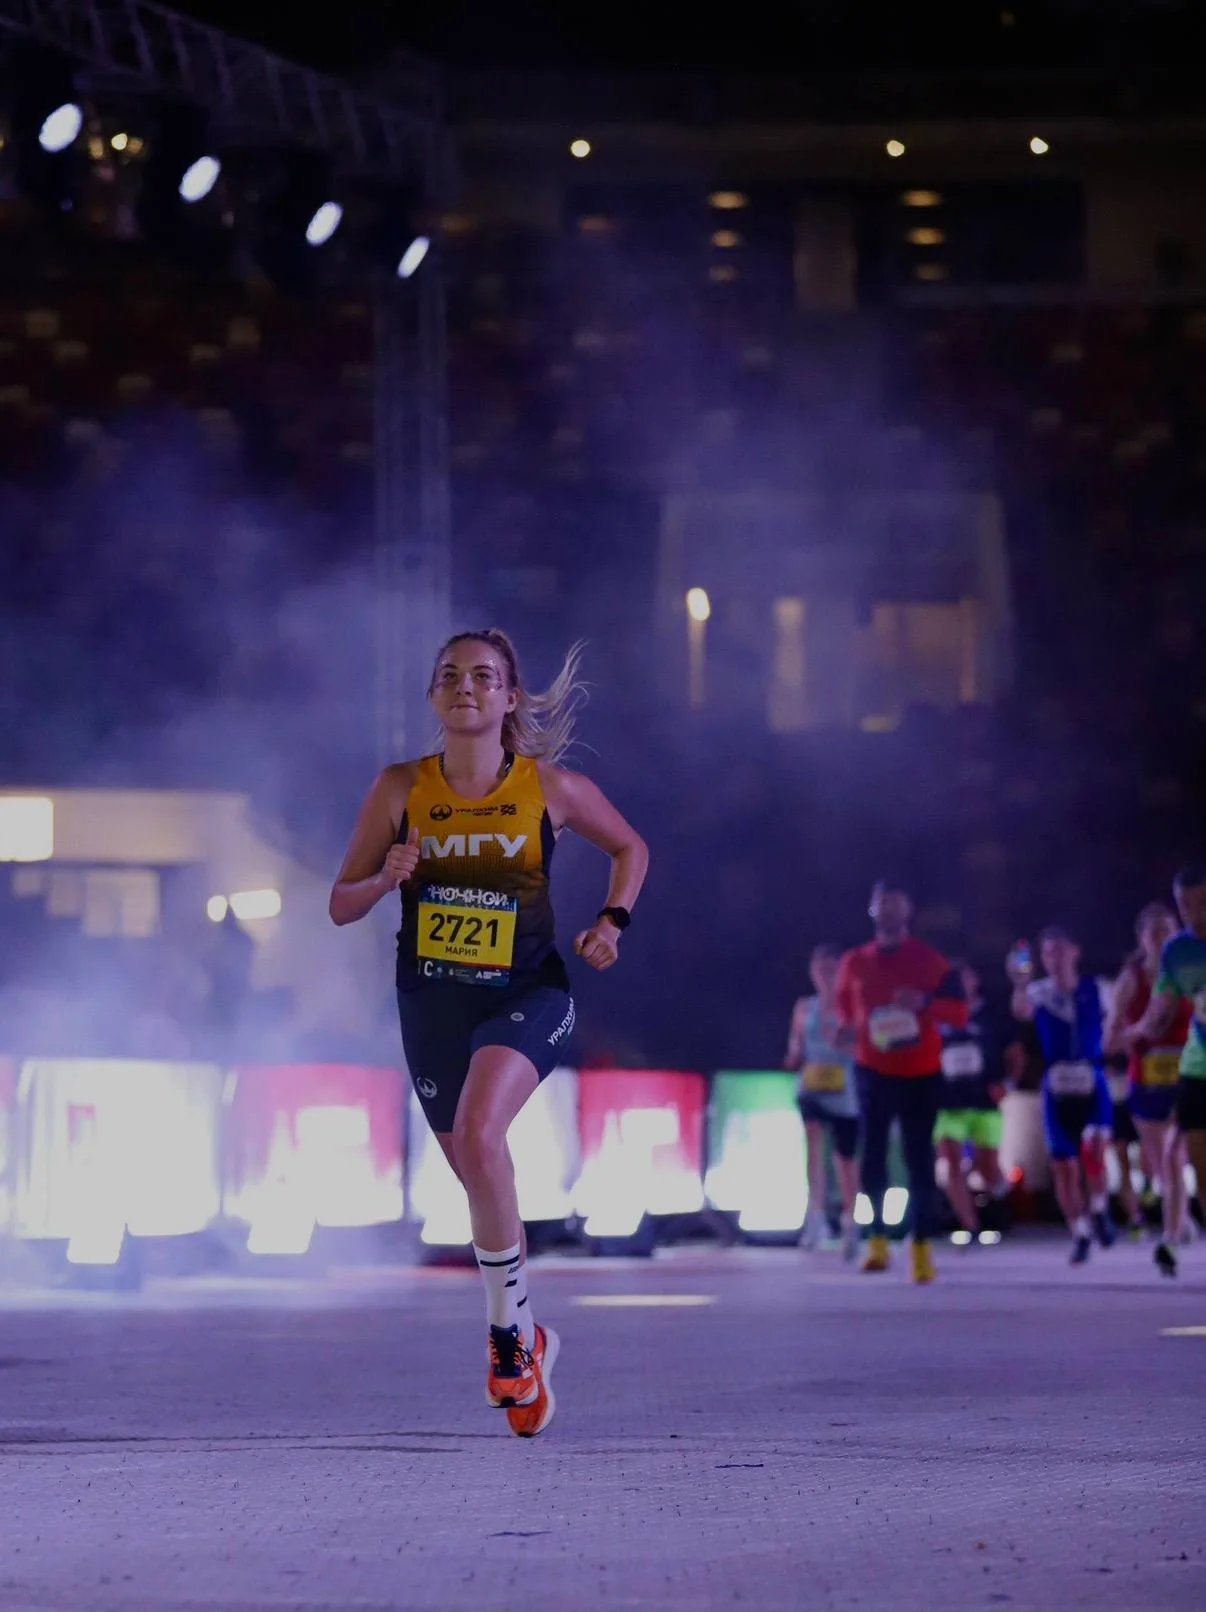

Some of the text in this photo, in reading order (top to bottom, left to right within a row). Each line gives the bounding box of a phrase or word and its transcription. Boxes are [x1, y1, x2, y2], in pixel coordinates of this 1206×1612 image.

[421, 833, 528, 859] МГУ
[429, 912, 499, 947] 2721
[445, 946, 478, 956] МАРИЯ
